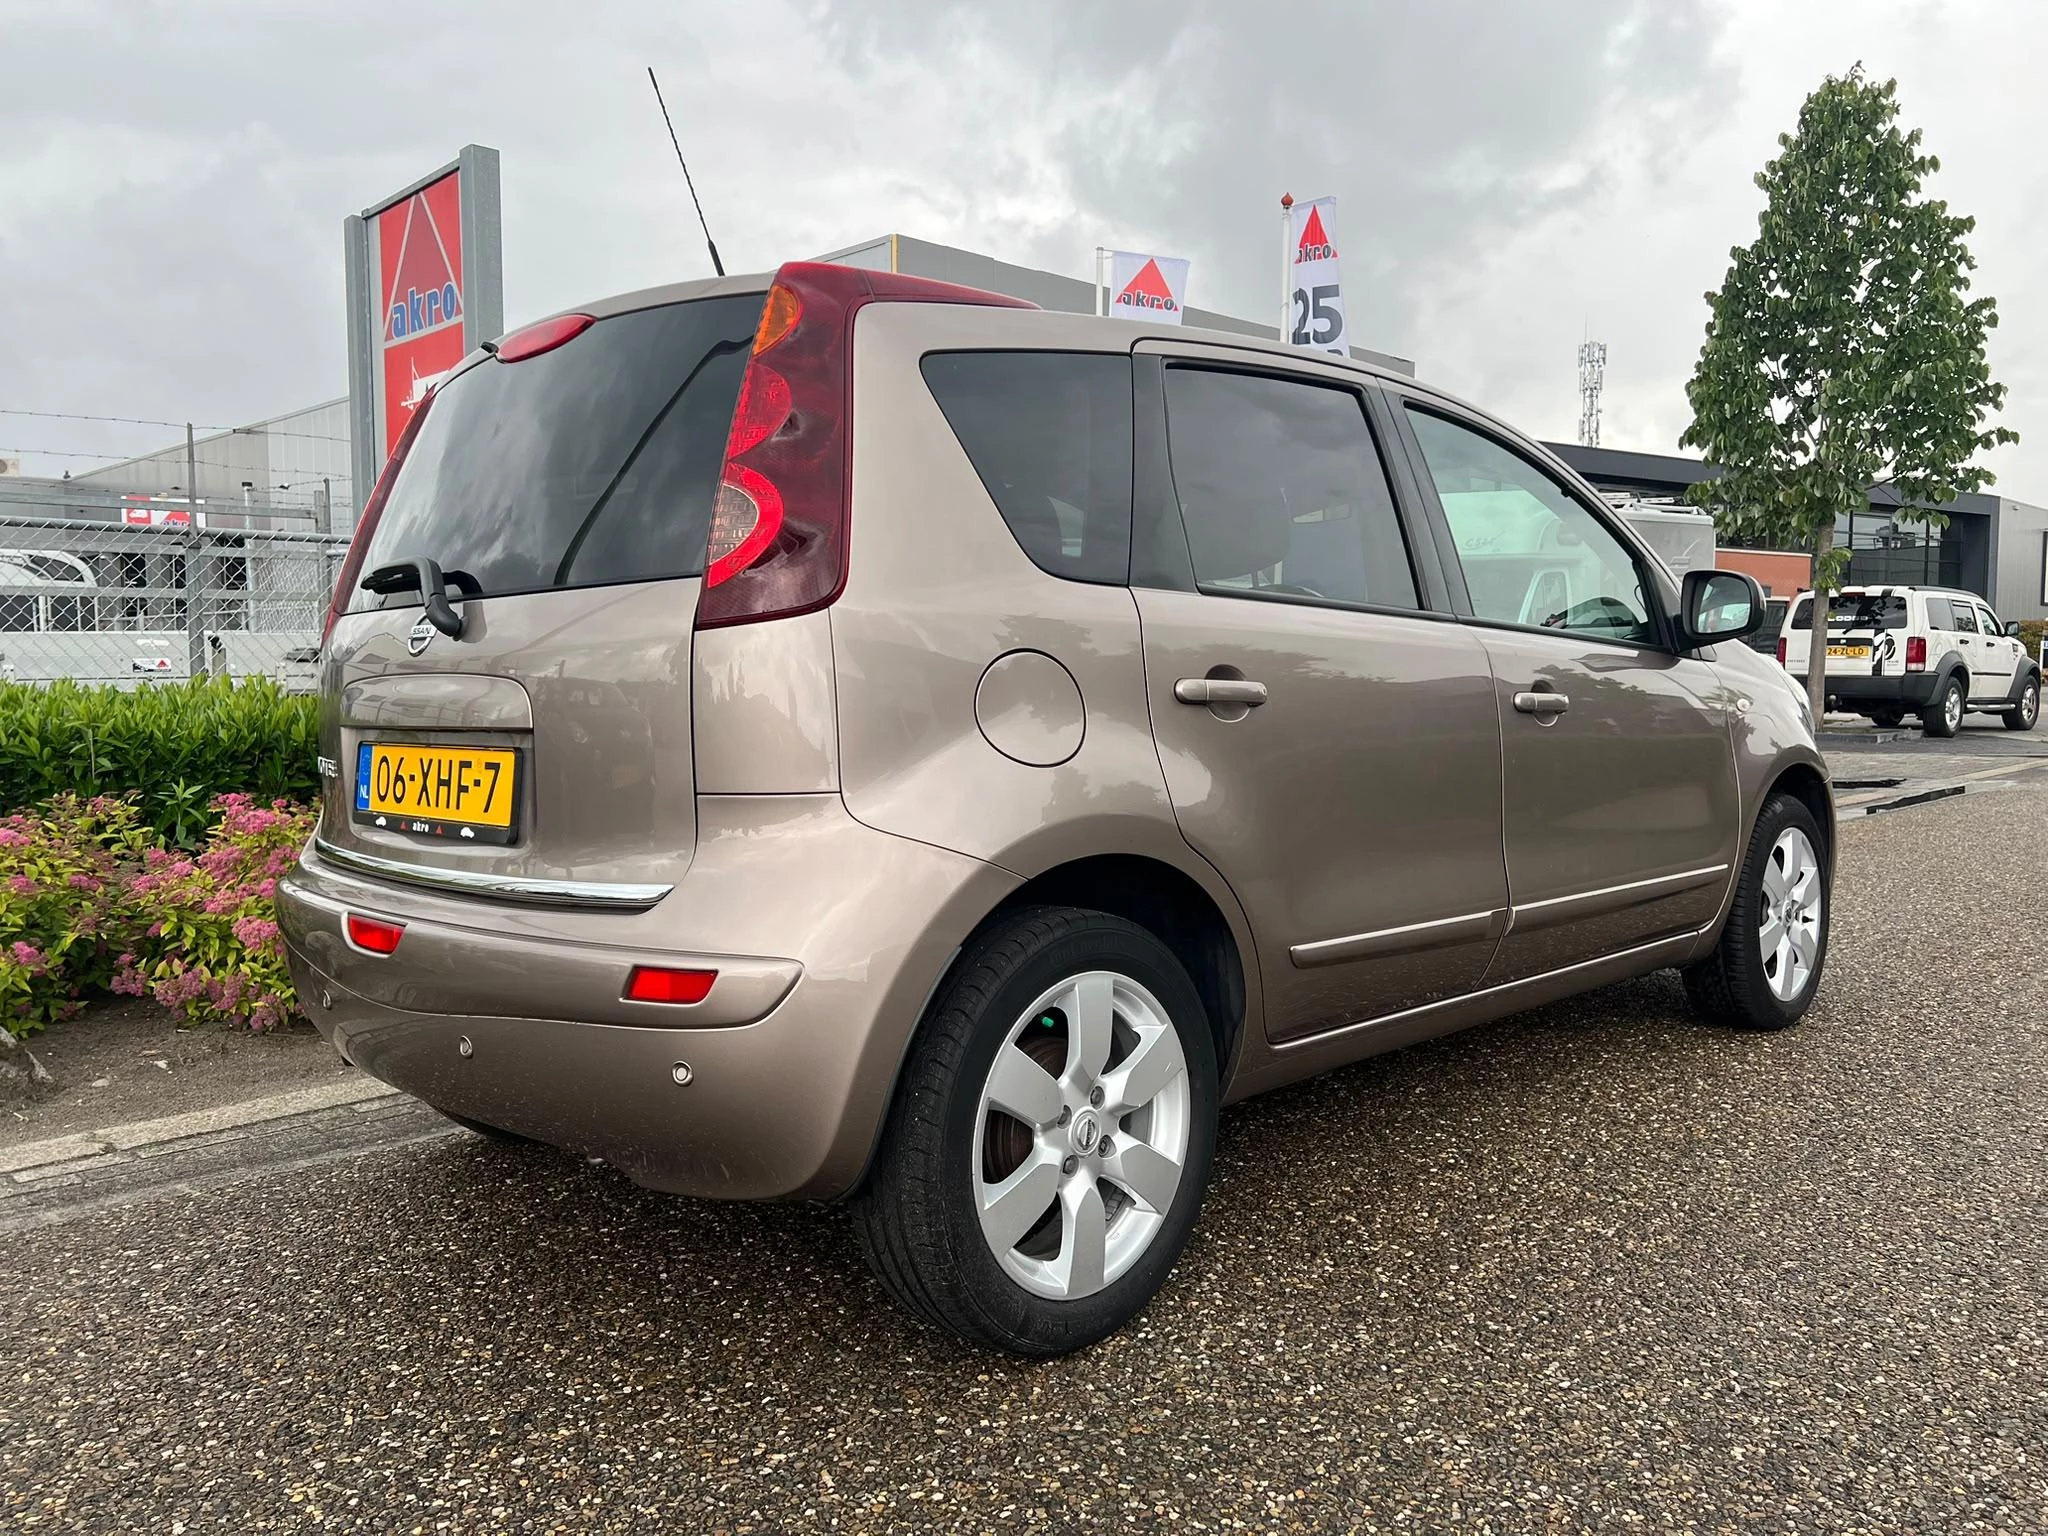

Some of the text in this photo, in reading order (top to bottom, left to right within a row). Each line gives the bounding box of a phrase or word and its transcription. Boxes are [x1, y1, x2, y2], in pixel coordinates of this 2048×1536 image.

[391, 282, 457, 339] akro
[1122, 291, 1175, 311] akro
[1292, 284, 1343, 344] 25
[1827, 647, 1864, 656] 24-ZL-LD
[359, 784, 370, 799] NL
[376, 755, 502, 813] 06-XHF-7
[412, 821, 430, 833] akro
